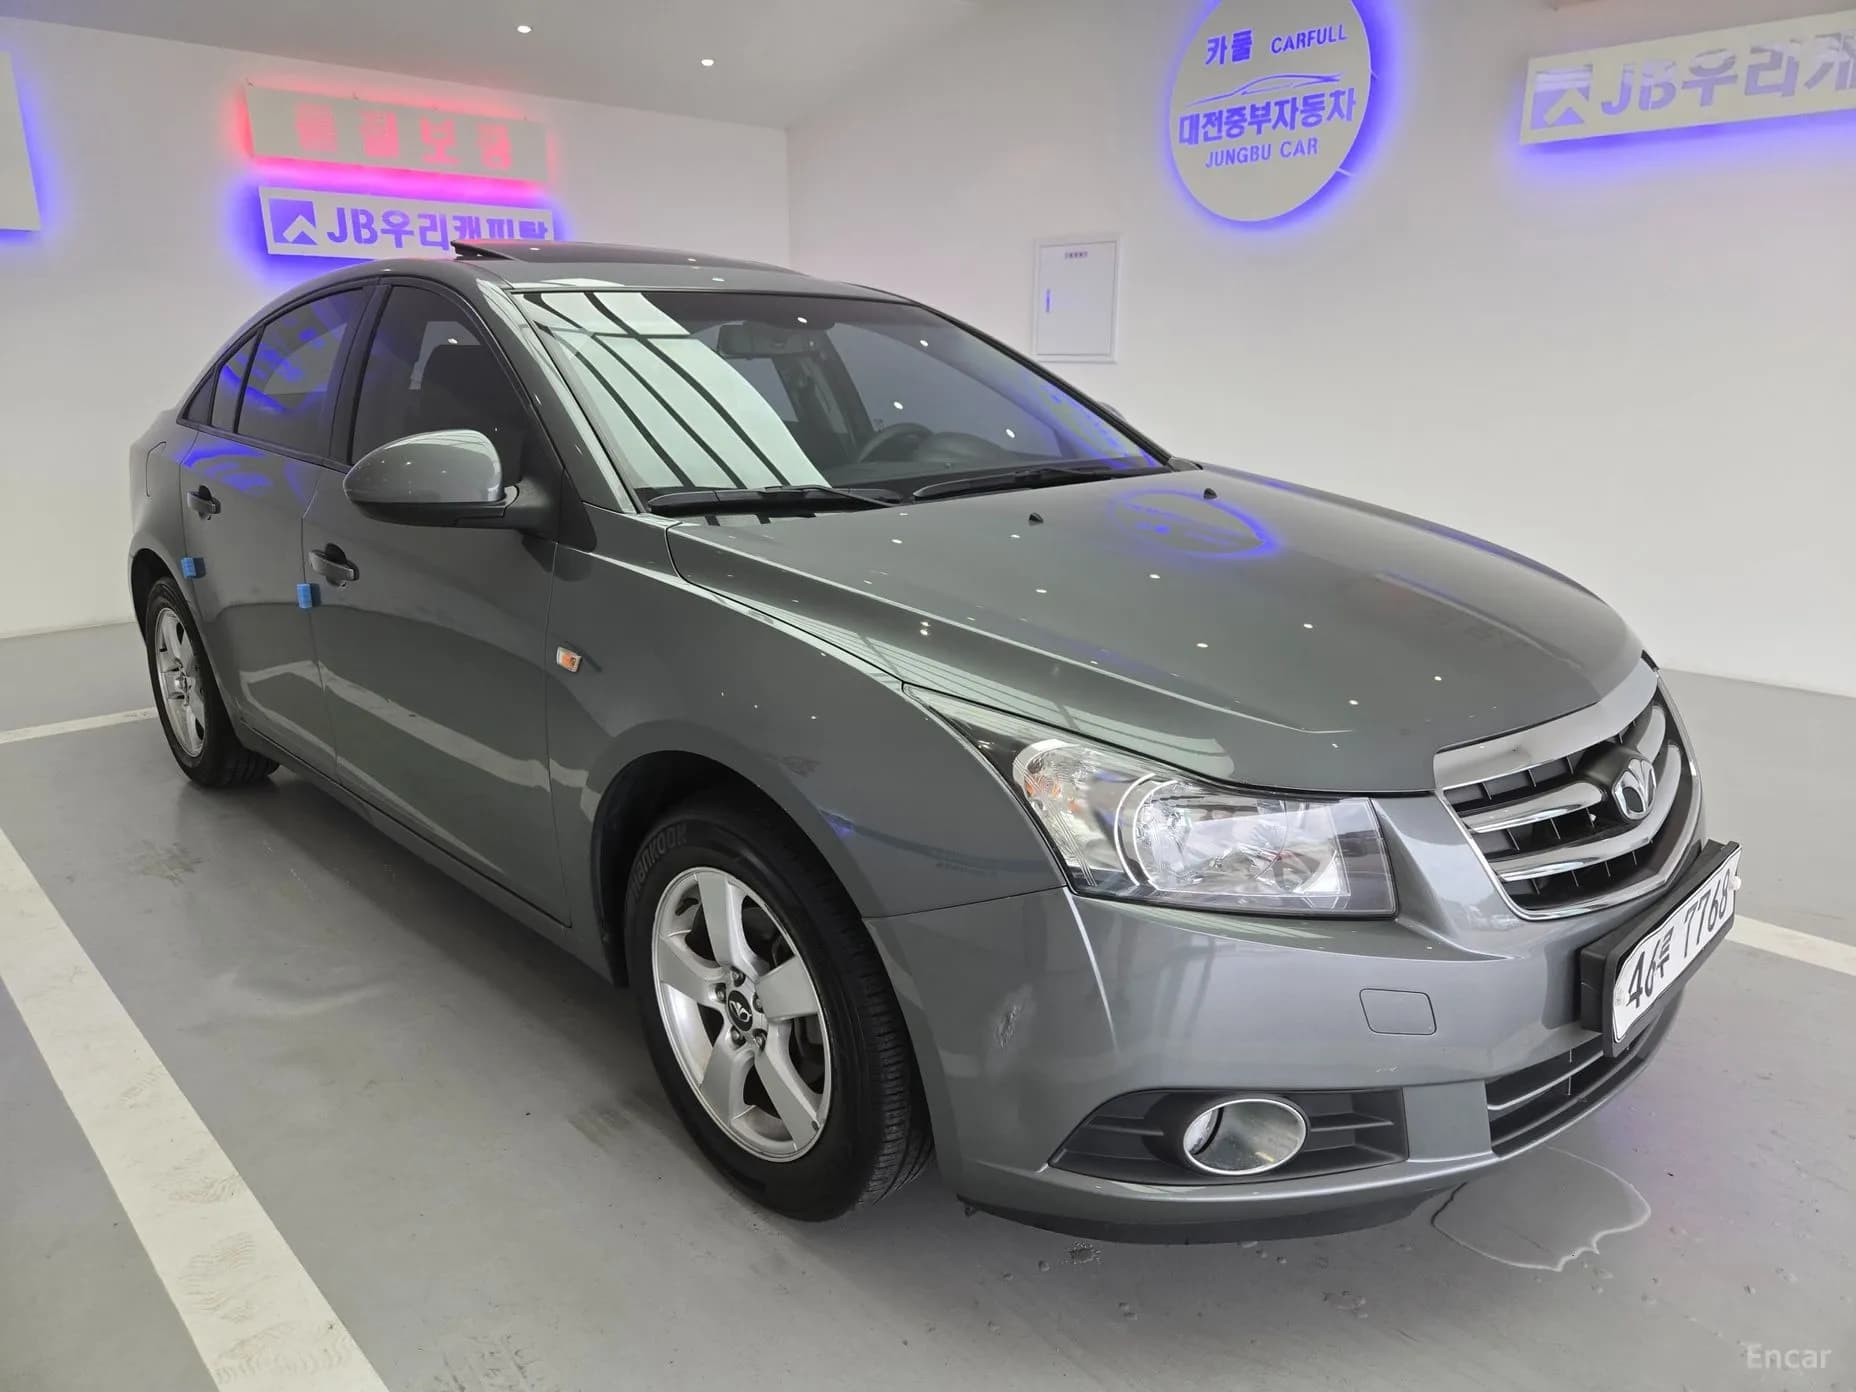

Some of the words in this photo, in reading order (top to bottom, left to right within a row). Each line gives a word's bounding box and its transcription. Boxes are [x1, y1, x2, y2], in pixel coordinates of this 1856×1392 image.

[1271, 24, 1348, 54] CARFULL
[1178, 87, 1356, 146] 대전중부자동차
[1205, 143, 1272, 169] JUNGBU
[1280, 137, 1319, 158] CAR
[1684, 867, 1731, 959] 7768
